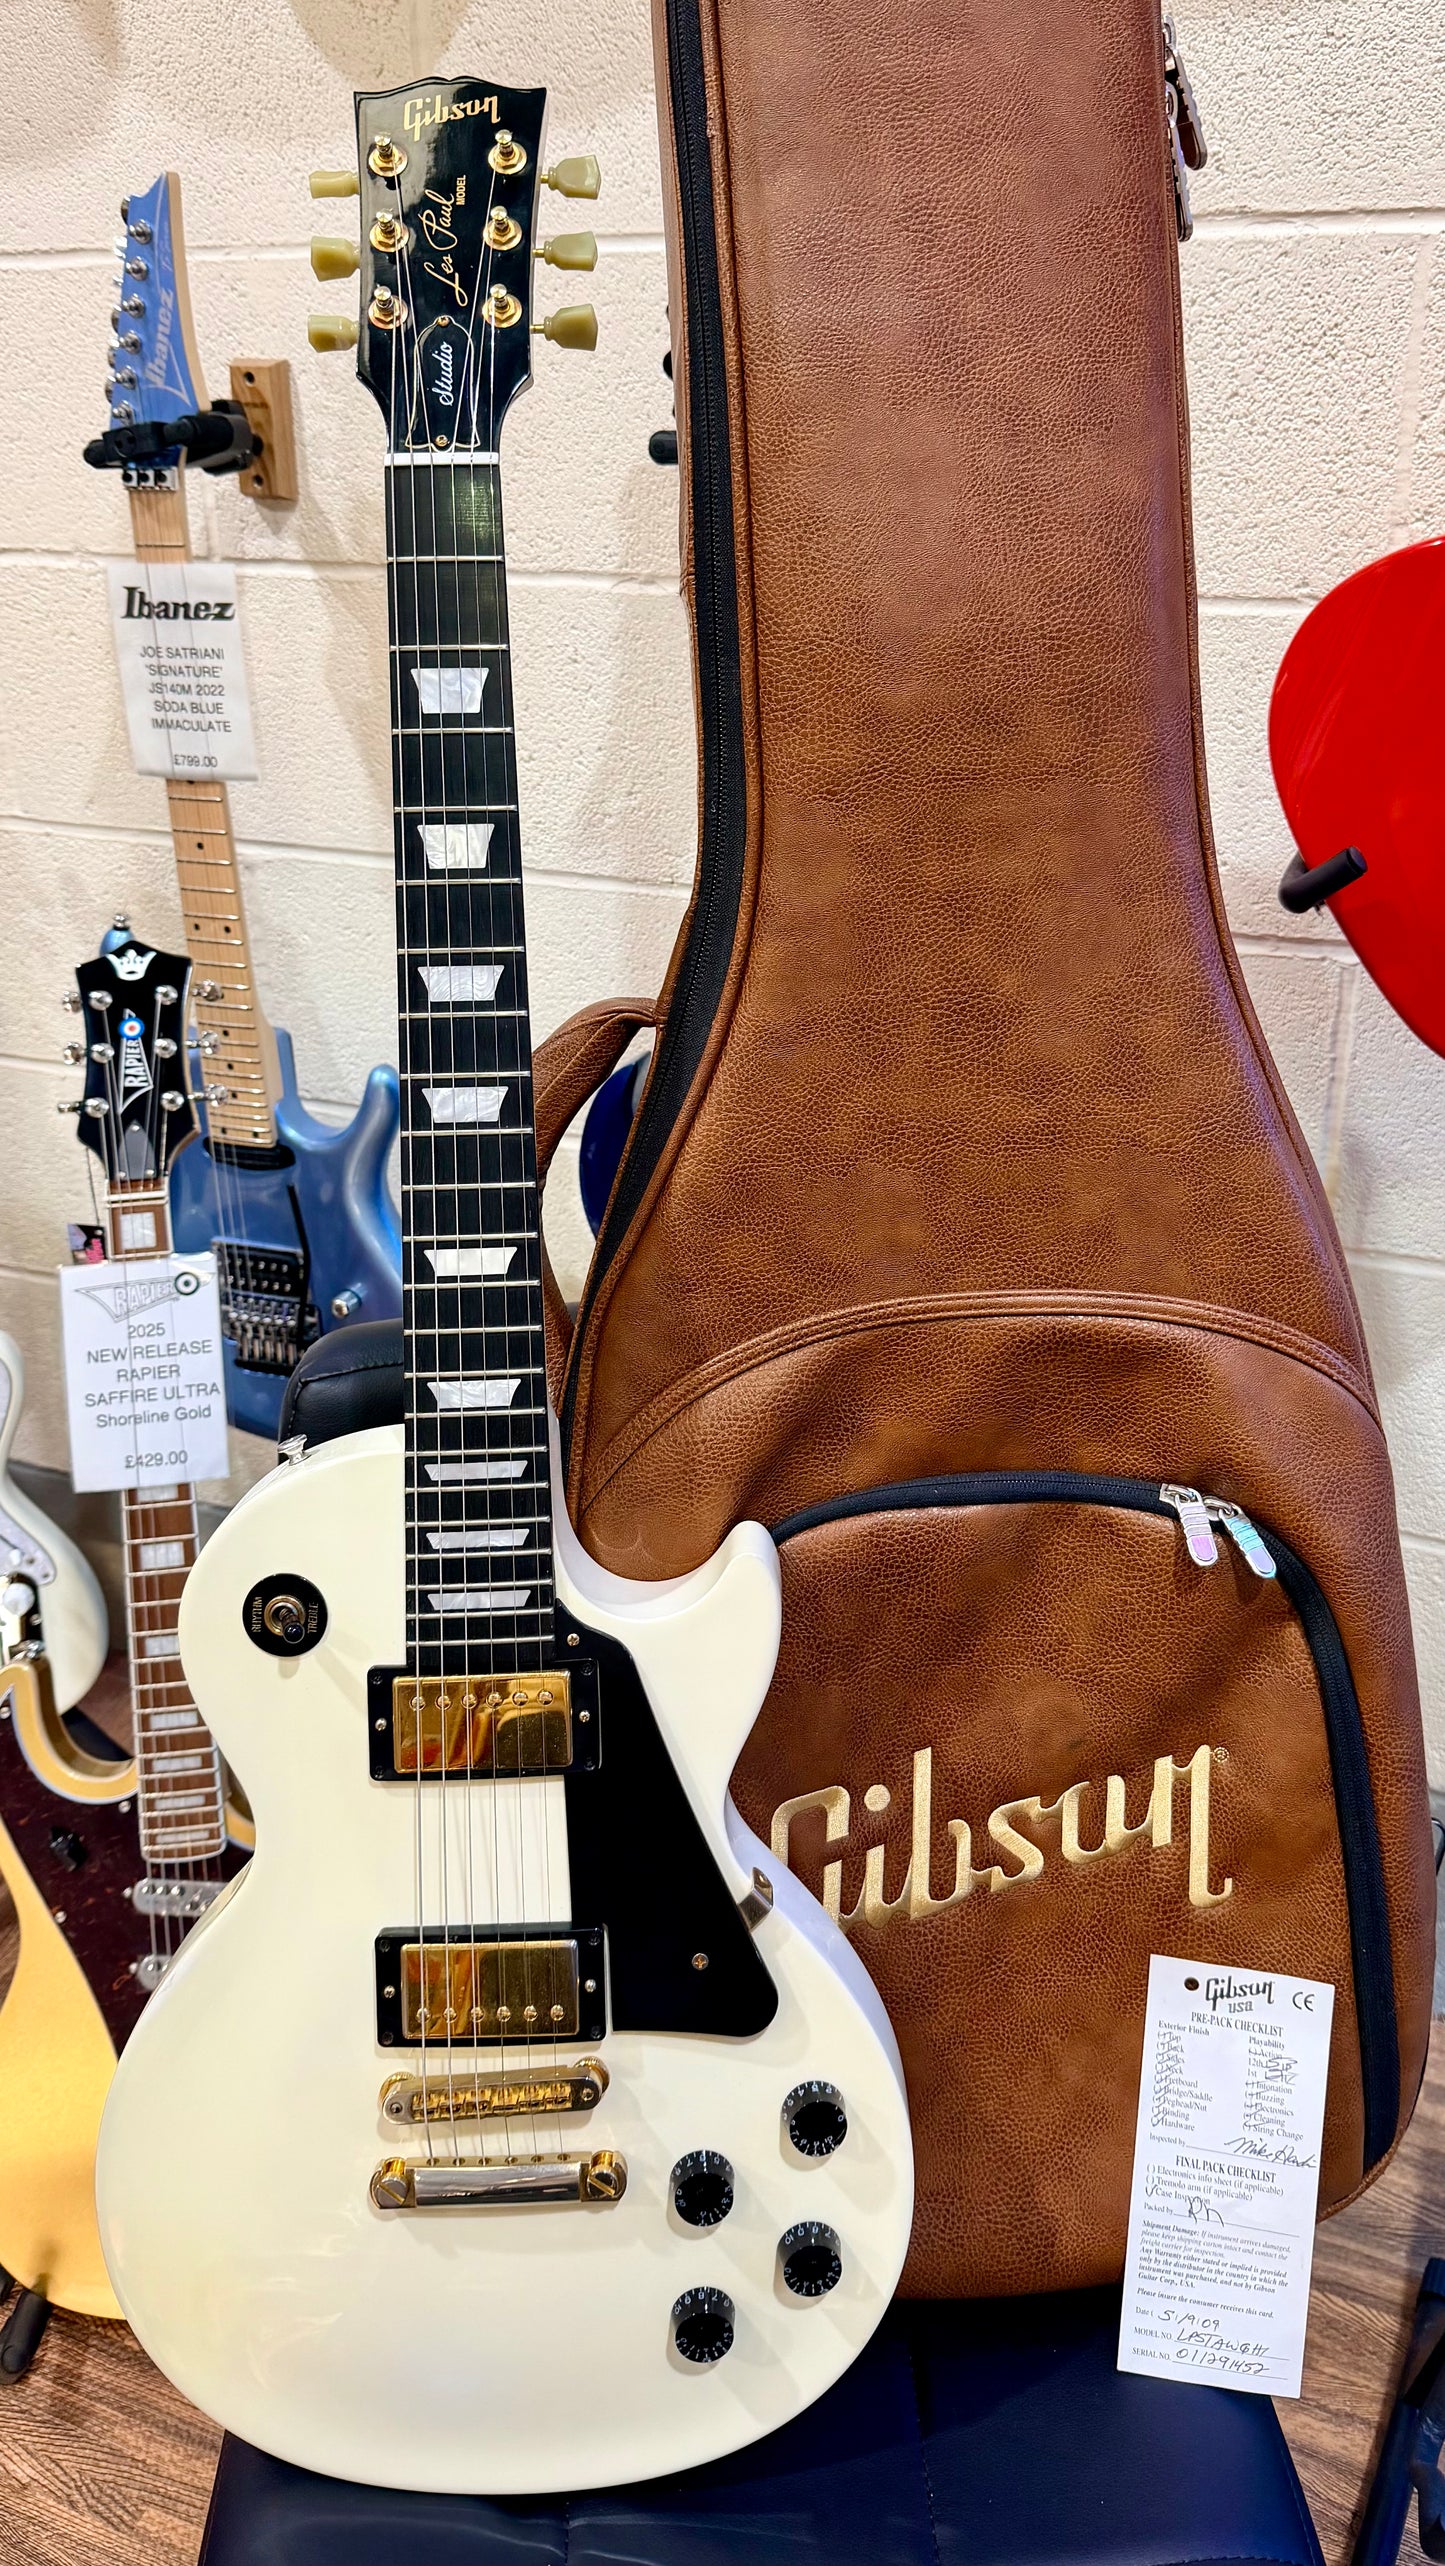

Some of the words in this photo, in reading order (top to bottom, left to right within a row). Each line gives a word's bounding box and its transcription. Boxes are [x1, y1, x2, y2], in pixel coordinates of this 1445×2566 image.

[403, 93, 501, 141] Gibson
[455, 174, 467, 206] MODEL
[420, 189, 458, 250] Paul
[422, 248, 468, 307] Les
[143, 287, 174, 389] Ibanez
[431, 341, 454, 407] Studio
[121, 586, 236, 622] Ibanez
[140, 645, 164, 659] JOE
[167, 647, 225, 660] SATRIANI
[149, 682, 193, 696] JS140M
[196, 683, 225, 697] 2022
[154, 700, 188, 713] SODA
[190, 701, 225, 716] BLUE
[152, 718, 233, 733] IMMACULATE
[174, 754, 219, 769] £799.00
[124, 1038, 148, 1088] RAPIER
[113, 1280, 174, 1318] RAPIER
[127, 1322, 166, 1338] 2025
[87, 1348, 128, 1364] NEW
[133, 1339, 213, 1360] RELEASE
[117, 1364, 181, 1383] RAPIER
[85, 1386, 158, 1408] SAFFIRE
[163, 1381, 221, 1401] ULTRA
[96, 1410, 170, 1429] Shoreline
[174, 1404, 212, 1422] Gold
[124, 1450, 188, 1469] £429.00
[251, 1596, 263, 1633] RHYTHM
[770, 1743, 1233, 1932] Gibson
[1205, 1976, 1275, 2011] Gibson
[1158, 2019, 1187, 2032] Exterior
[1188, 2024, 1210, 2036] Finish
[1191, 2011, 1233, 2029] PRE-PACK
[1234, 2019, 1284, 2038] CHECKLIST
[1249, 2036, 1285, 2051] Playability
[1164, 2085, 1213, 2102] Bridge/Saddle
[1256, 2080, 1293, 2095] Intonation
[1163, 2095, 1208, 2113] Peghead/Nut
[1255, 2091, 1285, 2106] Buzzing
[1162, 2106, 1190, 2122] Binding
[1255, 2103, 1294, 2117] Electronics
[1161, 2117, 1195, 2132] Hardware
[1253, 2112, 1286, 2128] Cleaning
[1150, 2132, 1177, 2145] Inspected
[1178, 2137, 1186, 2148] by
[1252, 2124, 1275, 2137] String
[1276, 2128, 1304, 2142] Change
[1176, 2155, 1201, 2170] FINAL
[1203, 2160, 1225, 2175] PACK
[1227, 2164, 1277, 2184] CHECKLIST
[1156, 2175, 1186, 2189] Tremolo
[1187, 2184, 1202, 2192] arm
[1203, 2184, 1213, 2195] (if
[1213, 2187, 1253, 2202] applicable)
[1157, 2165, 1196, 2180] Electronics
[1197, 2172, 1213, 2183] info
[1214, 2176, 1232, 2187] sheet
[1233, 2180, 1243, 2189] (if
[1244, 2182, 1284, 2197] applicable)
[1155, 2187, 1173, 2199] Case
[1144, 2201, 1165, 2213] Packed
[1165, 2206, 1173, 2216] by
[1142, 2219, 1171, 2231] Shipment
[1171, 2224, 1200, 2237] Damage:
[1161, 2232, 1176, 2242] keep
[1241, 2247, 1255, 2255] and
[1139, 2255, 1153, 2265] only
[1153, 2256, 1161, 2266] by
[1162, 2258, 1173, 2267] the
[1173, 2260, 1206, 2273] distributor
[1206, 2266, 1214, 2274] in
[1214, 2268, 1224, 2277] the
[1225, 2271, 1249, 2282] country
[1250, 2274, 1257, 2282] in
[1258, 2276, 1277, 2287] which
[1277, 2279, 1289, 2288] the
[1140, 2246, 1153, 2255] Any
[1154, 2247, 1182, 2261] Warranty
[1182, 2254, 1201, 2263] either
[1202, 2258, 1221, 2267] stated
[1229, 2261, 1253, 2272] implied
[1259, 2268, 1288, 2279] provided
[1138, 2271, 1158, 2282] Guitar
[1138, 2263, 1171, 2275] instrument
[1172, 2270, 1184, 2278] was
[1219, 2279, 1233, 2287] and
[1244, 2282, 1252, 2291] by
[1253, 2283, 1276, 2294] Gibson
[1135, 2306, 1150, 2316] Date
[1136, 2287, 1157, 2298] Please
[1157, 2290, 1177, 2302] insure
[1177, 2294, 1188, 2304] the
[1188, 2297, 1219, 2309] consumer
[1219, 2302, 1245, 2314] receives
[1245, 2306, 1258, 2316] this
[1258, 2309, 1275, 2319] card.
[1134, 2326, 1160, 2339] MODEL
[1161, 2332, 1174, 2341] NO.
[1132, 2347, 1158, 2359] SERIAL
[1159, 2352, 1172, 2361] NO.
